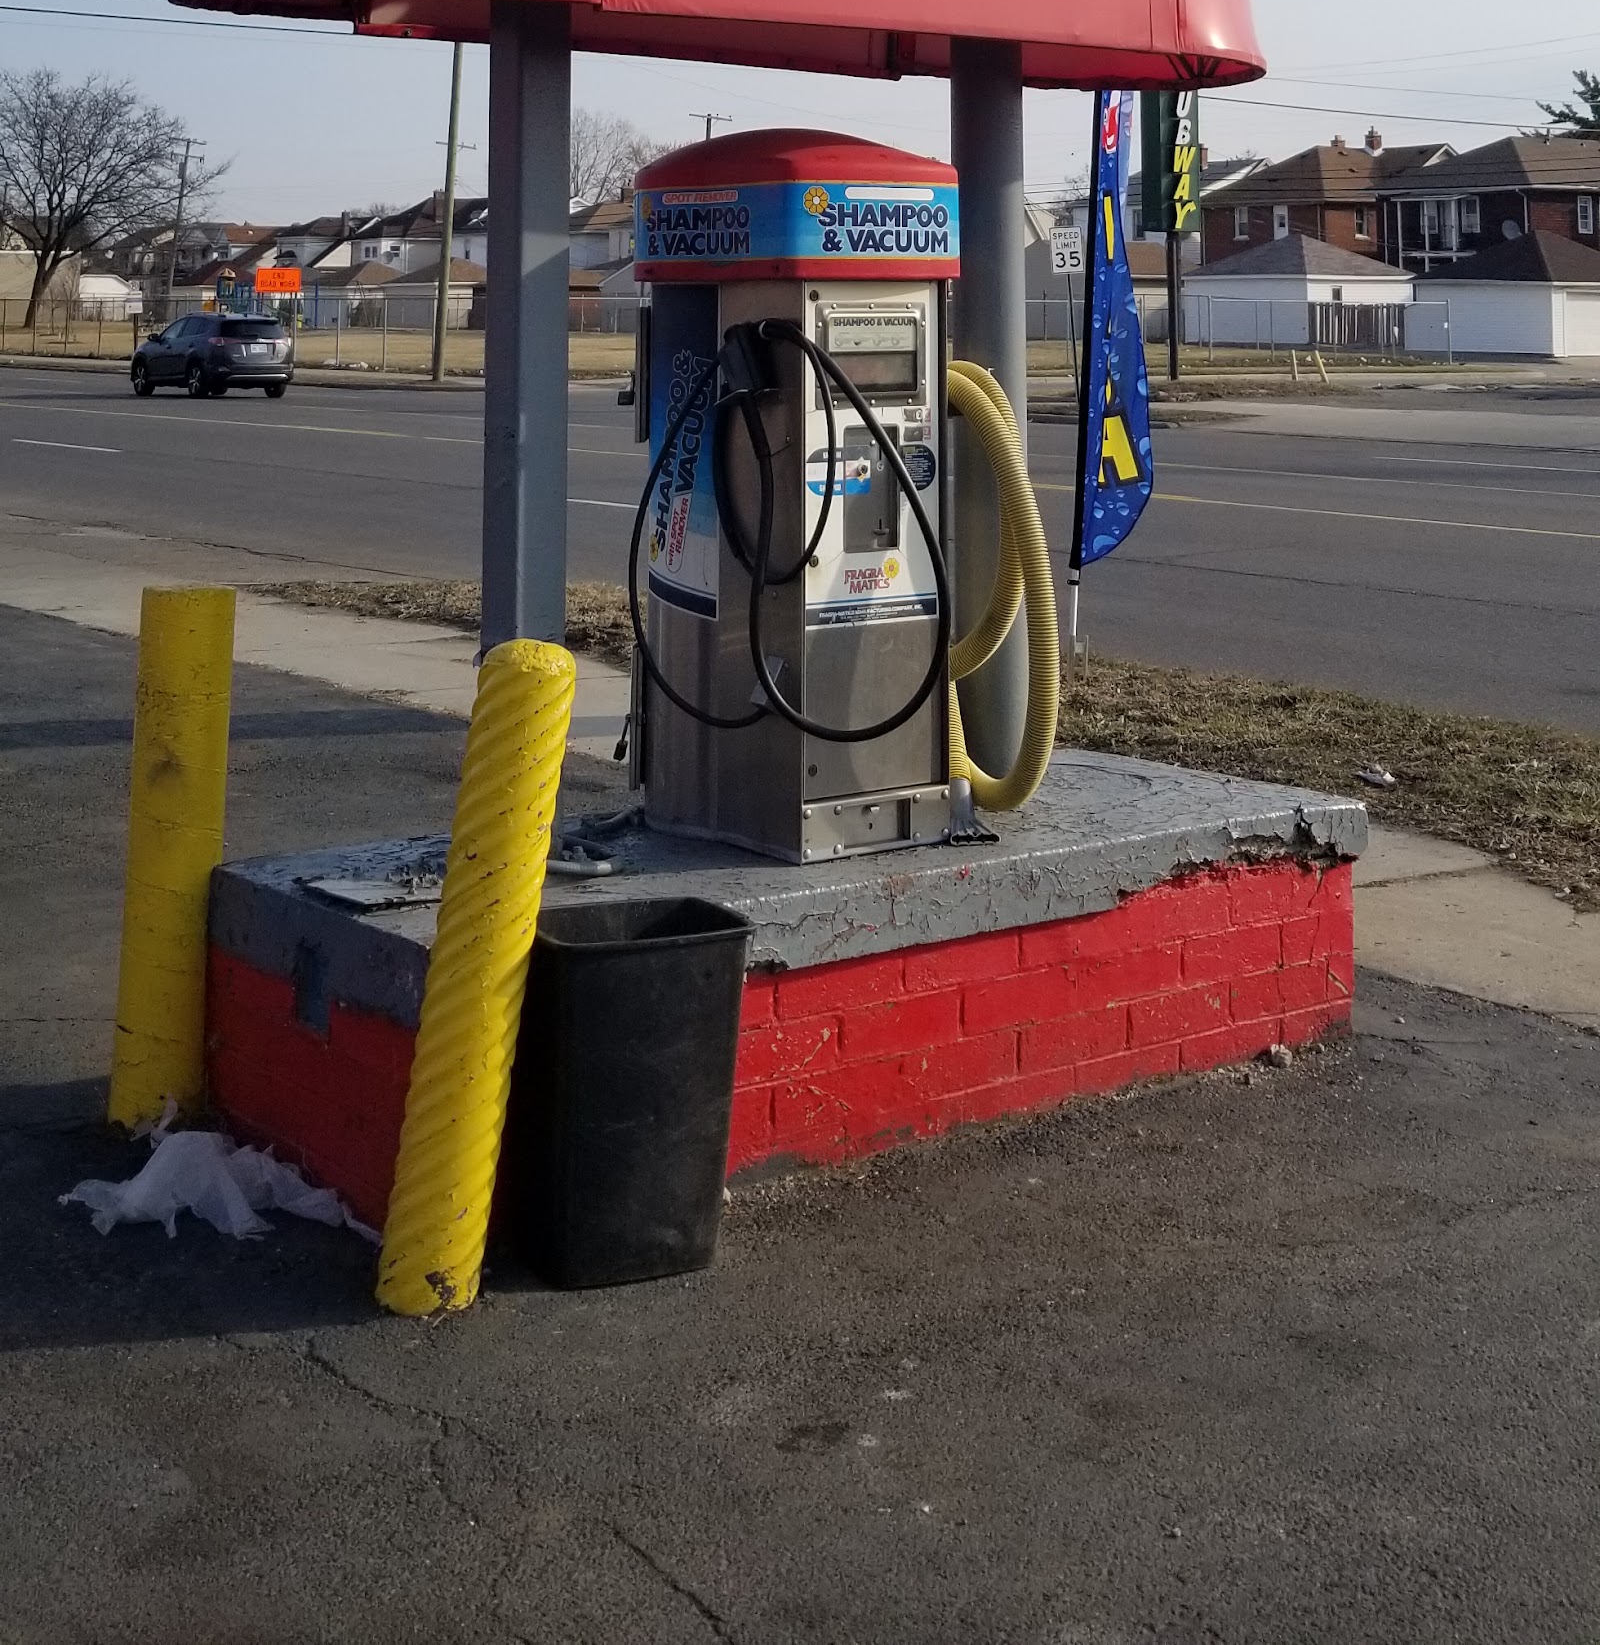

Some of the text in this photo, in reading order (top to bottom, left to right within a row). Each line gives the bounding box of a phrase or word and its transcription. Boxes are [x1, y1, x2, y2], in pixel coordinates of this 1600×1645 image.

[664, 191, 737, 204] SPOT REMOVER
[646, 205, 750, 232] SHAMPOO
[818, 203, 948, 228] SHAMPOO
[647, 231, 750, 256] & VACUUM
[822, 229, 948, 253] & VACUUM
[1052, 232, 1080, 240] SPEED
[1055, 241, 1077, 250] LIMIT
[1055, 251, 1081, 268] 35
[833, 318, 916, 327] SHAMPOO & VACUUM
[671, 508, 680, 539] SPOT
[675, 497, 689, 554] REMOVER
[844, 567, 884, 584] FRAGRA
[849, 578, 890, 594] MATICS
